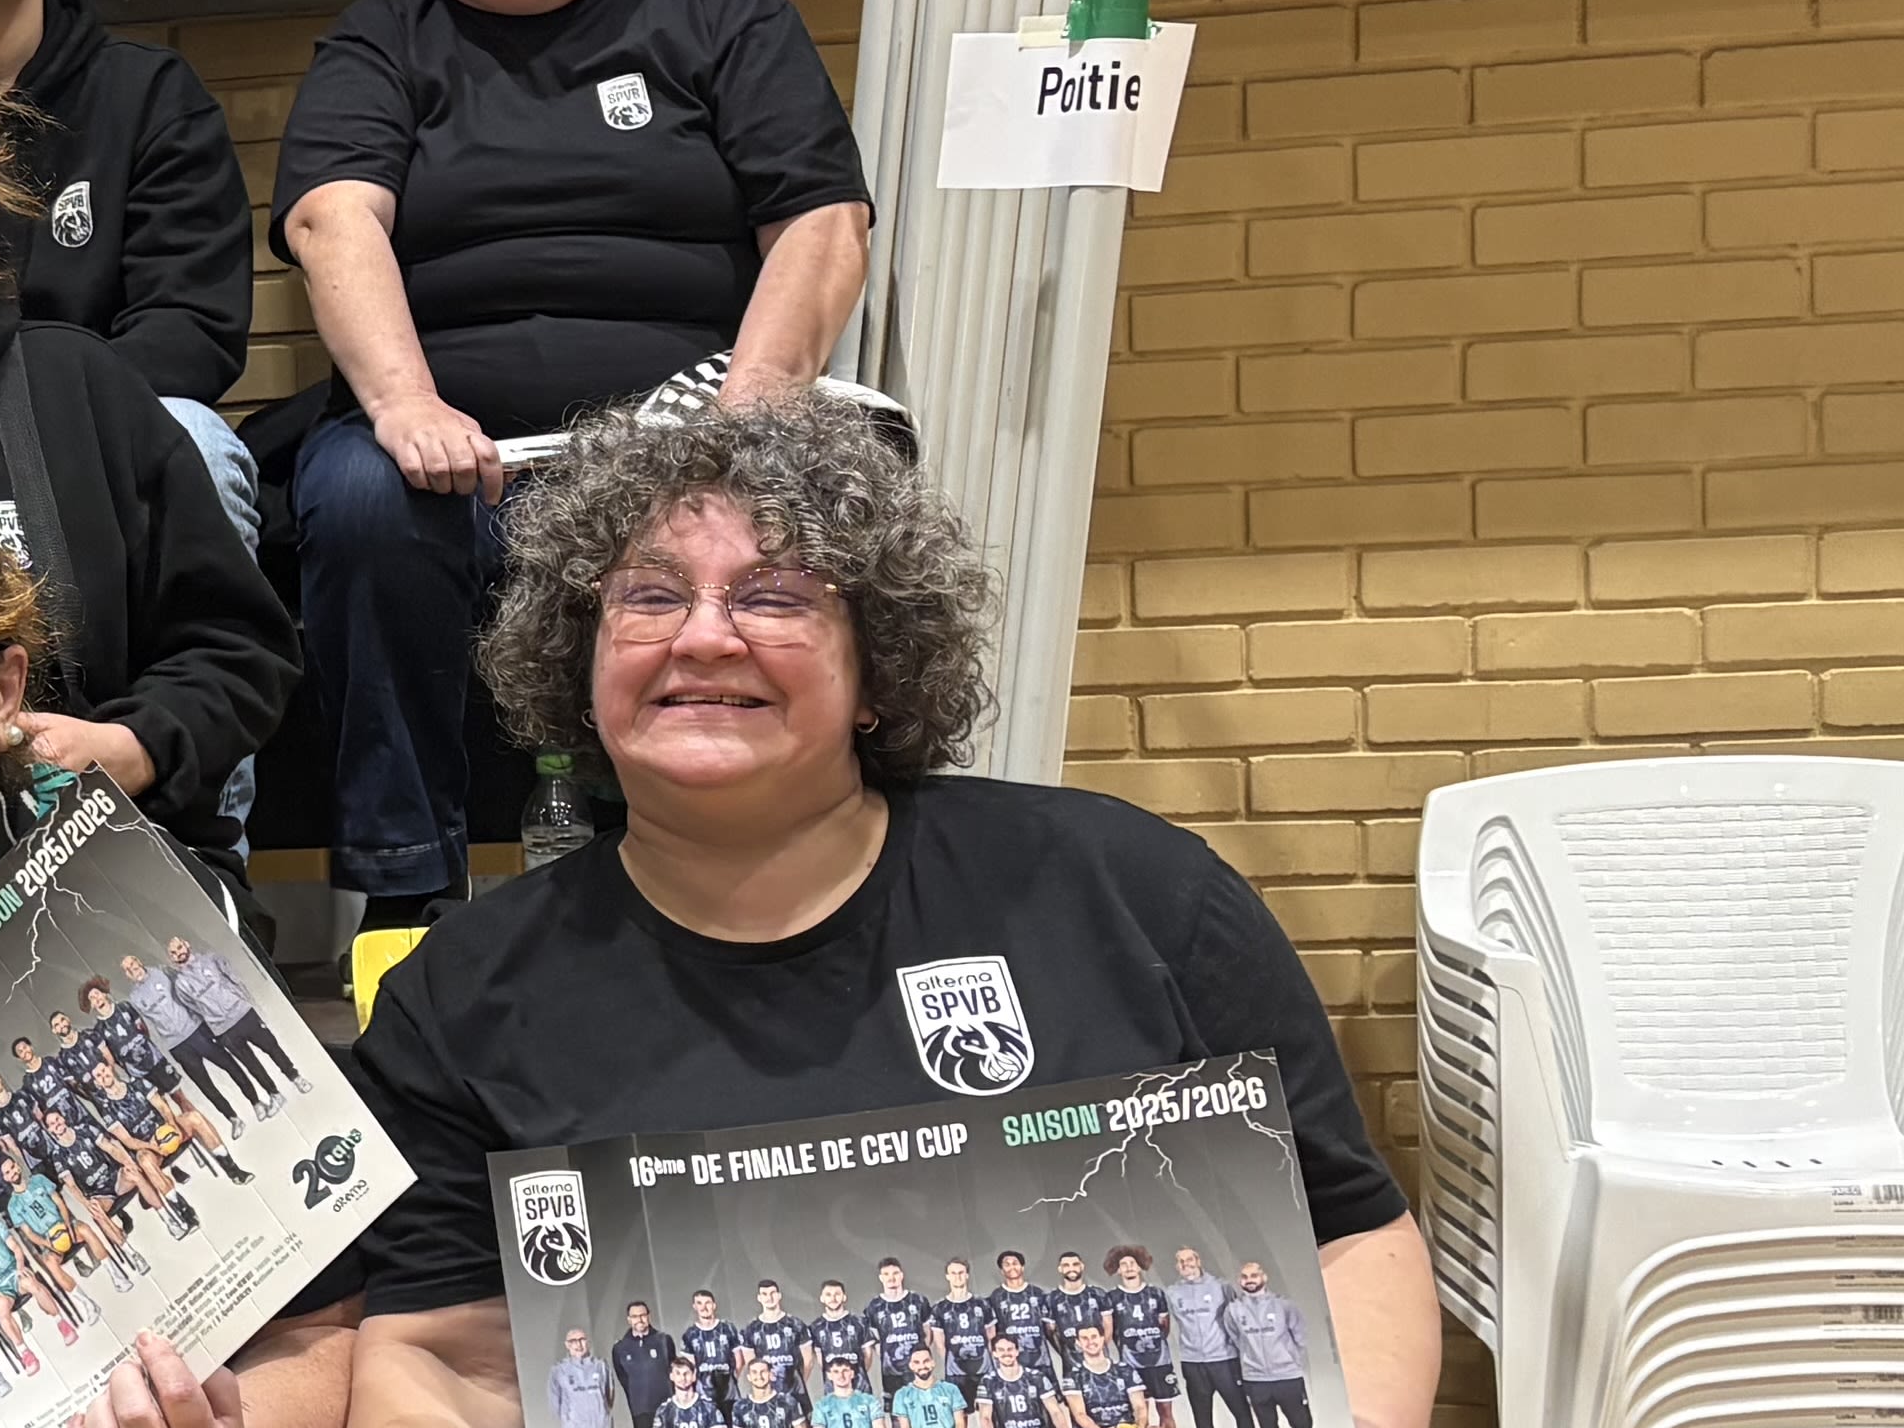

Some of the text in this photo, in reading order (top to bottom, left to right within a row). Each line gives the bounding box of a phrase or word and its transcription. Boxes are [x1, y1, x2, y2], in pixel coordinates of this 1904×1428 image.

[15, 788, 118, 898] 2025/2026
[921, 986, 1002, 1020] SPVB
[629, 1076, 1267, 1187] 16ème DE FINALE DE CEV CUP SAISON 2025/2026
[292, 1135, 355, 1210] 20
[524, 1194, 576, 1220] SPVB
[890, 1312, 906, 1328] 12
[1009, 1303, 1030, 1320] 22
[1132, 1305, 1145, 1321] 4
[766, 1333, 781, 1349] 10
[832, 1331, 843, 1348] 5
[1009, 1394, 1027, 1413] 16
[922, 1404, 938, 1422] 19
